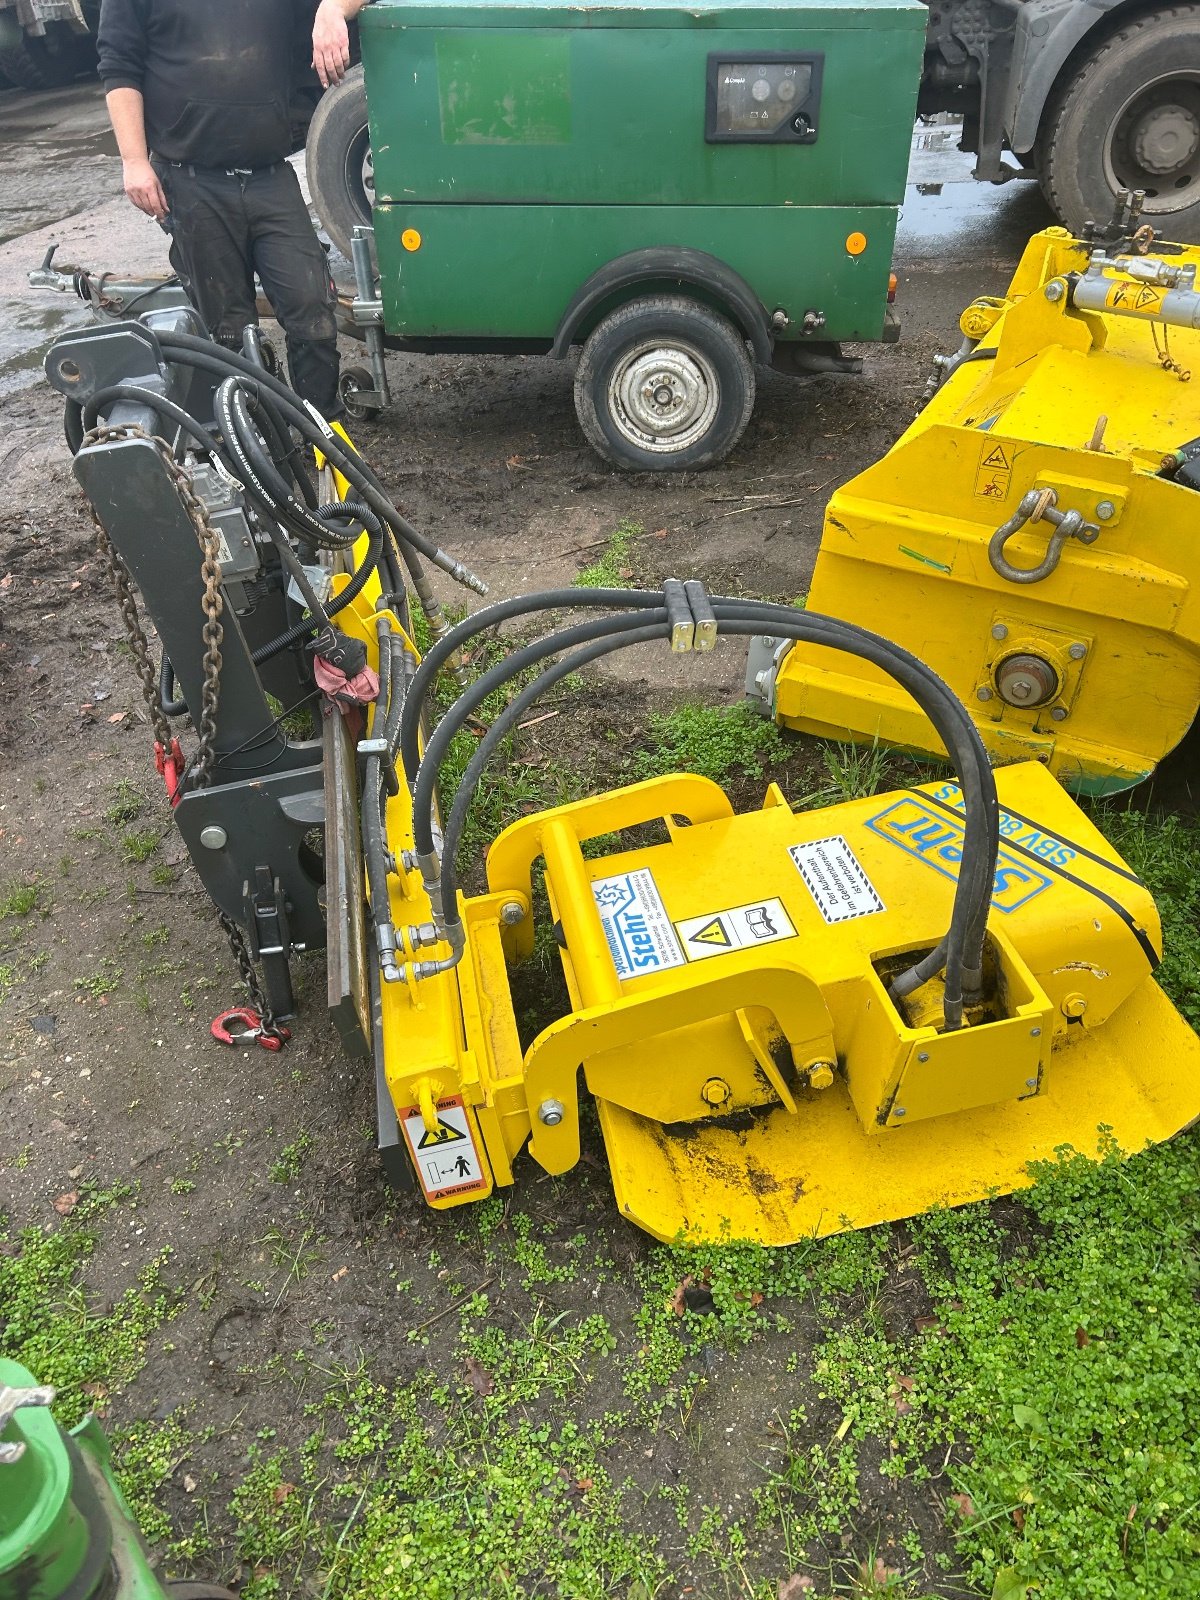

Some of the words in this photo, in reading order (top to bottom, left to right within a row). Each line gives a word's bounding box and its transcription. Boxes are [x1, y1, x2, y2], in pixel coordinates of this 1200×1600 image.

[889, 816, 1031, 893] Sehr
[1016, 832, 1076, 865] SBV
[807, 858, 831, 891] Aufenthalt
[816, 847, 851, 900] Gefahrenbereich
[836, 856, 856, 884] verboten
[827, 892, 838, 905] Der
[852, 885, 862, 894] ist
[847, 901, 857, 911] im
[623, 912, 660, 967] Stehr
[444, 1182, 481, 1196] WARNUNG
